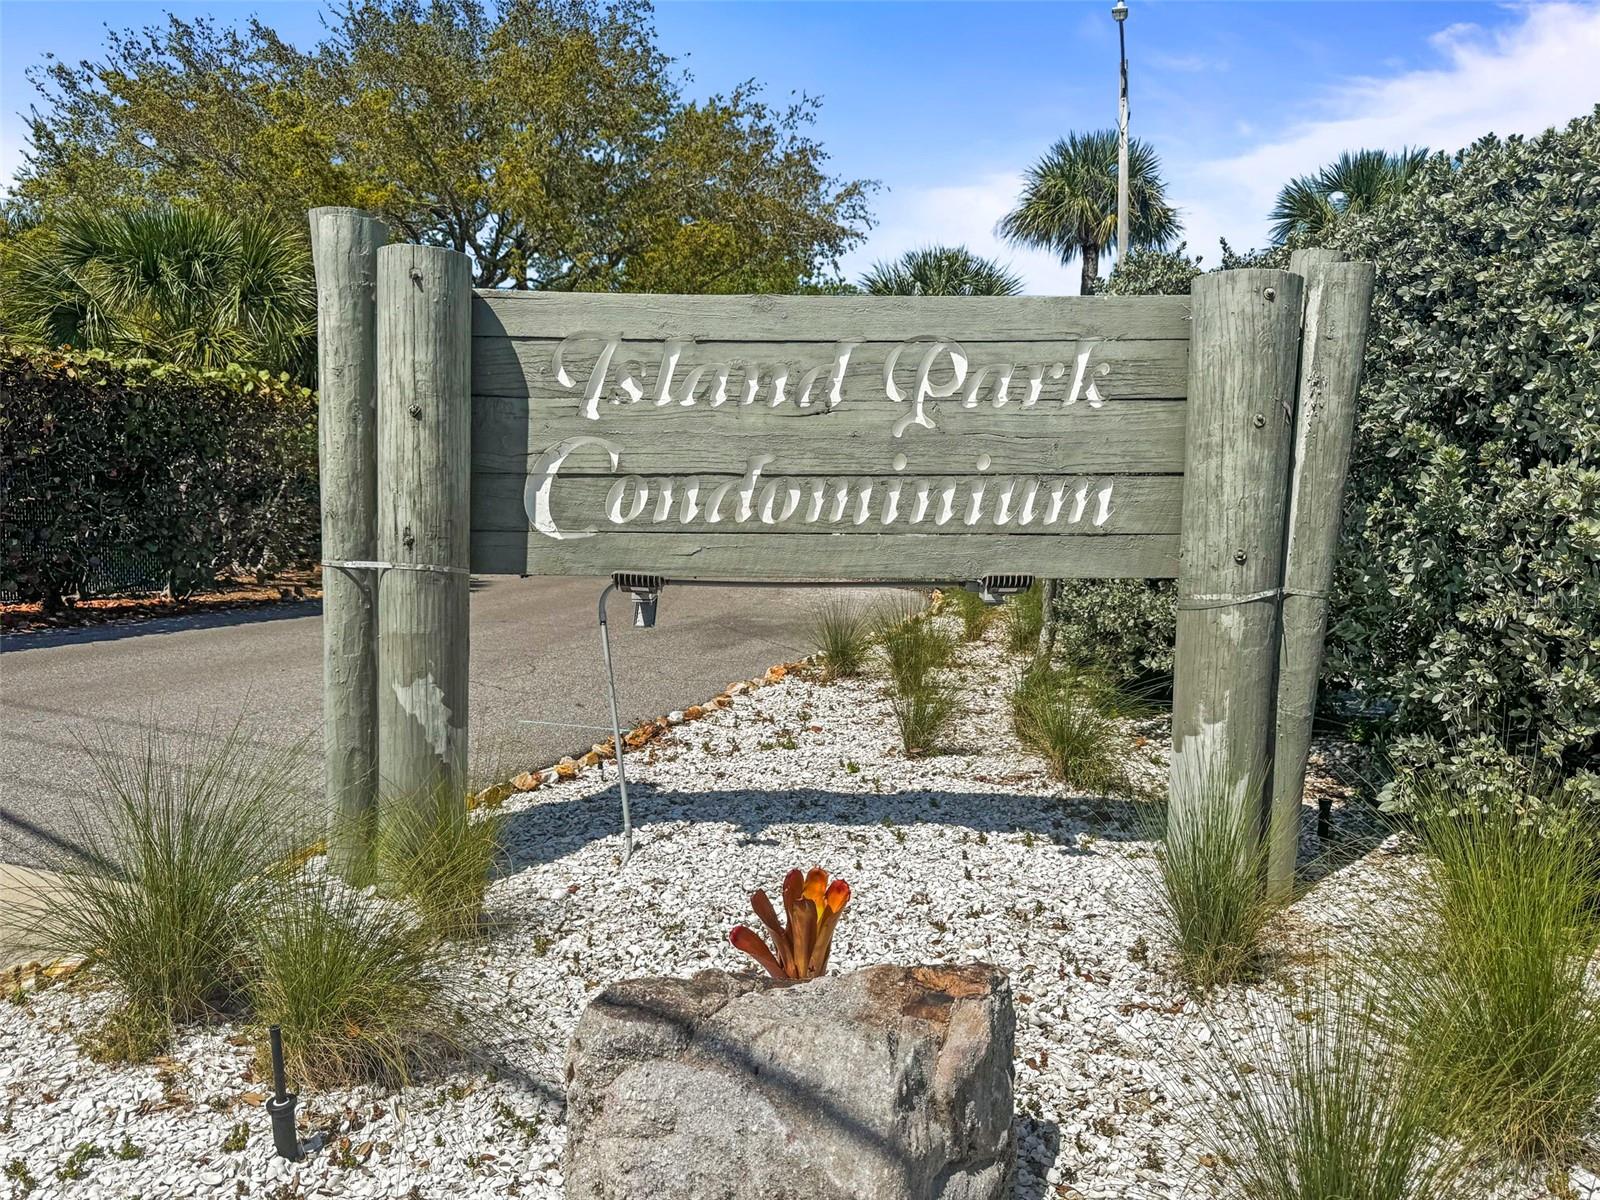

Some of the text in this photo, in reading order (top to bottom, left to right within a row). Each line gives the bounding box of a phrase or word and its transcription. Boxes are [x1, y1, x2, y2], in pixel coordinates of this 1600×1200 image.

[552, 330, 1111, 437] Island Park
[524, 436, 1115, 540] Condominium
